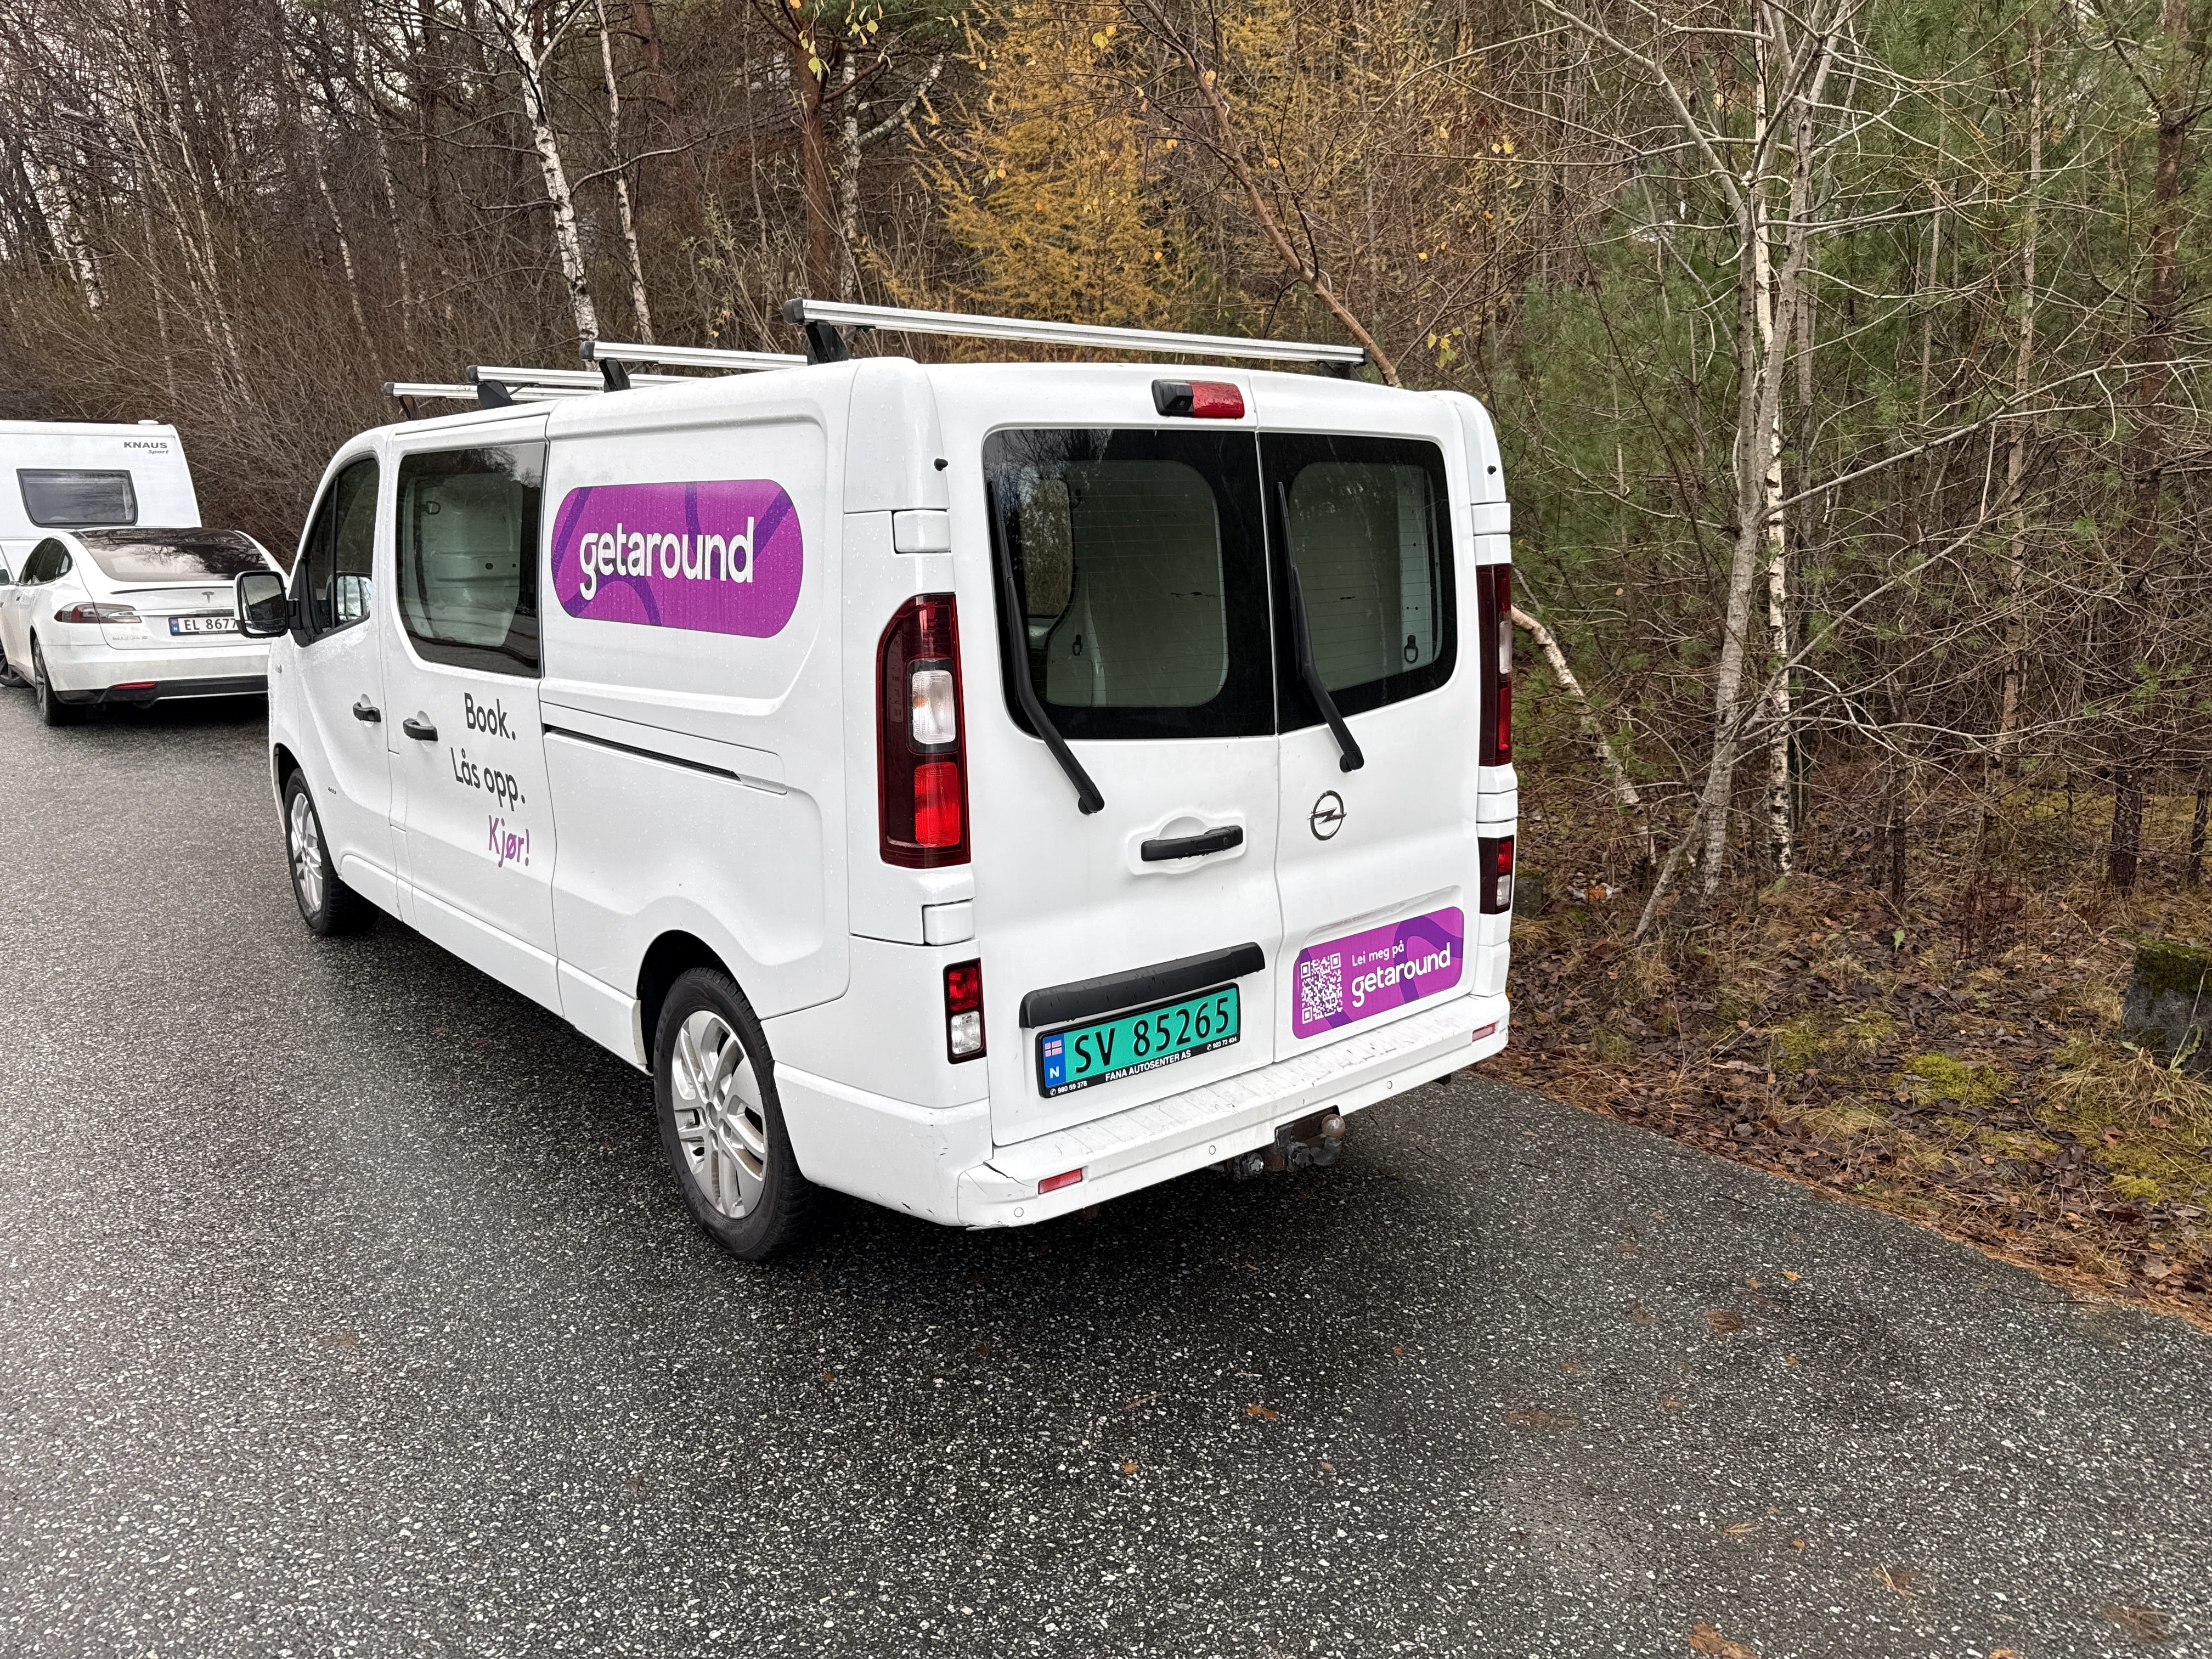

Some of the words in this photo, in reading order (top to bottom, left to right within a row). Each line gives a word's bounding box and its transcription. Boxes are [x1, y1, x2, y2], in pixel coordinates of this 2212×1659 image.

[579, 516, 754, 601] getaround
[184, 619, 200, 630] EL
[206, 618, 236, 629] 8677
[464, 692, 516, 741] Book.
[450, 747, 481, 789] Lås
[483, 767, 526, 812] opp.
[488, 815, 530, 868] Kjør!
[1351, 942, 1451, 1007] getaround
[1352, 951, 1366, 967] Lei
[1368, 947, 1389, 962] meg
[1392, 940, 1404, 956] på
[1074, 1027, 1116, 1074] SV
[1133, 996, 1229, 1057] 85265
[1049, 1066, 1059, 1079] N
[1077, 1080, 1087, 1088] 378
[1105, 1070, 1127, 1082] FANA
[1128, 1053, 1180, 1075] AUTOSENTER
[1181, 1049, 1191, 1060] AS
